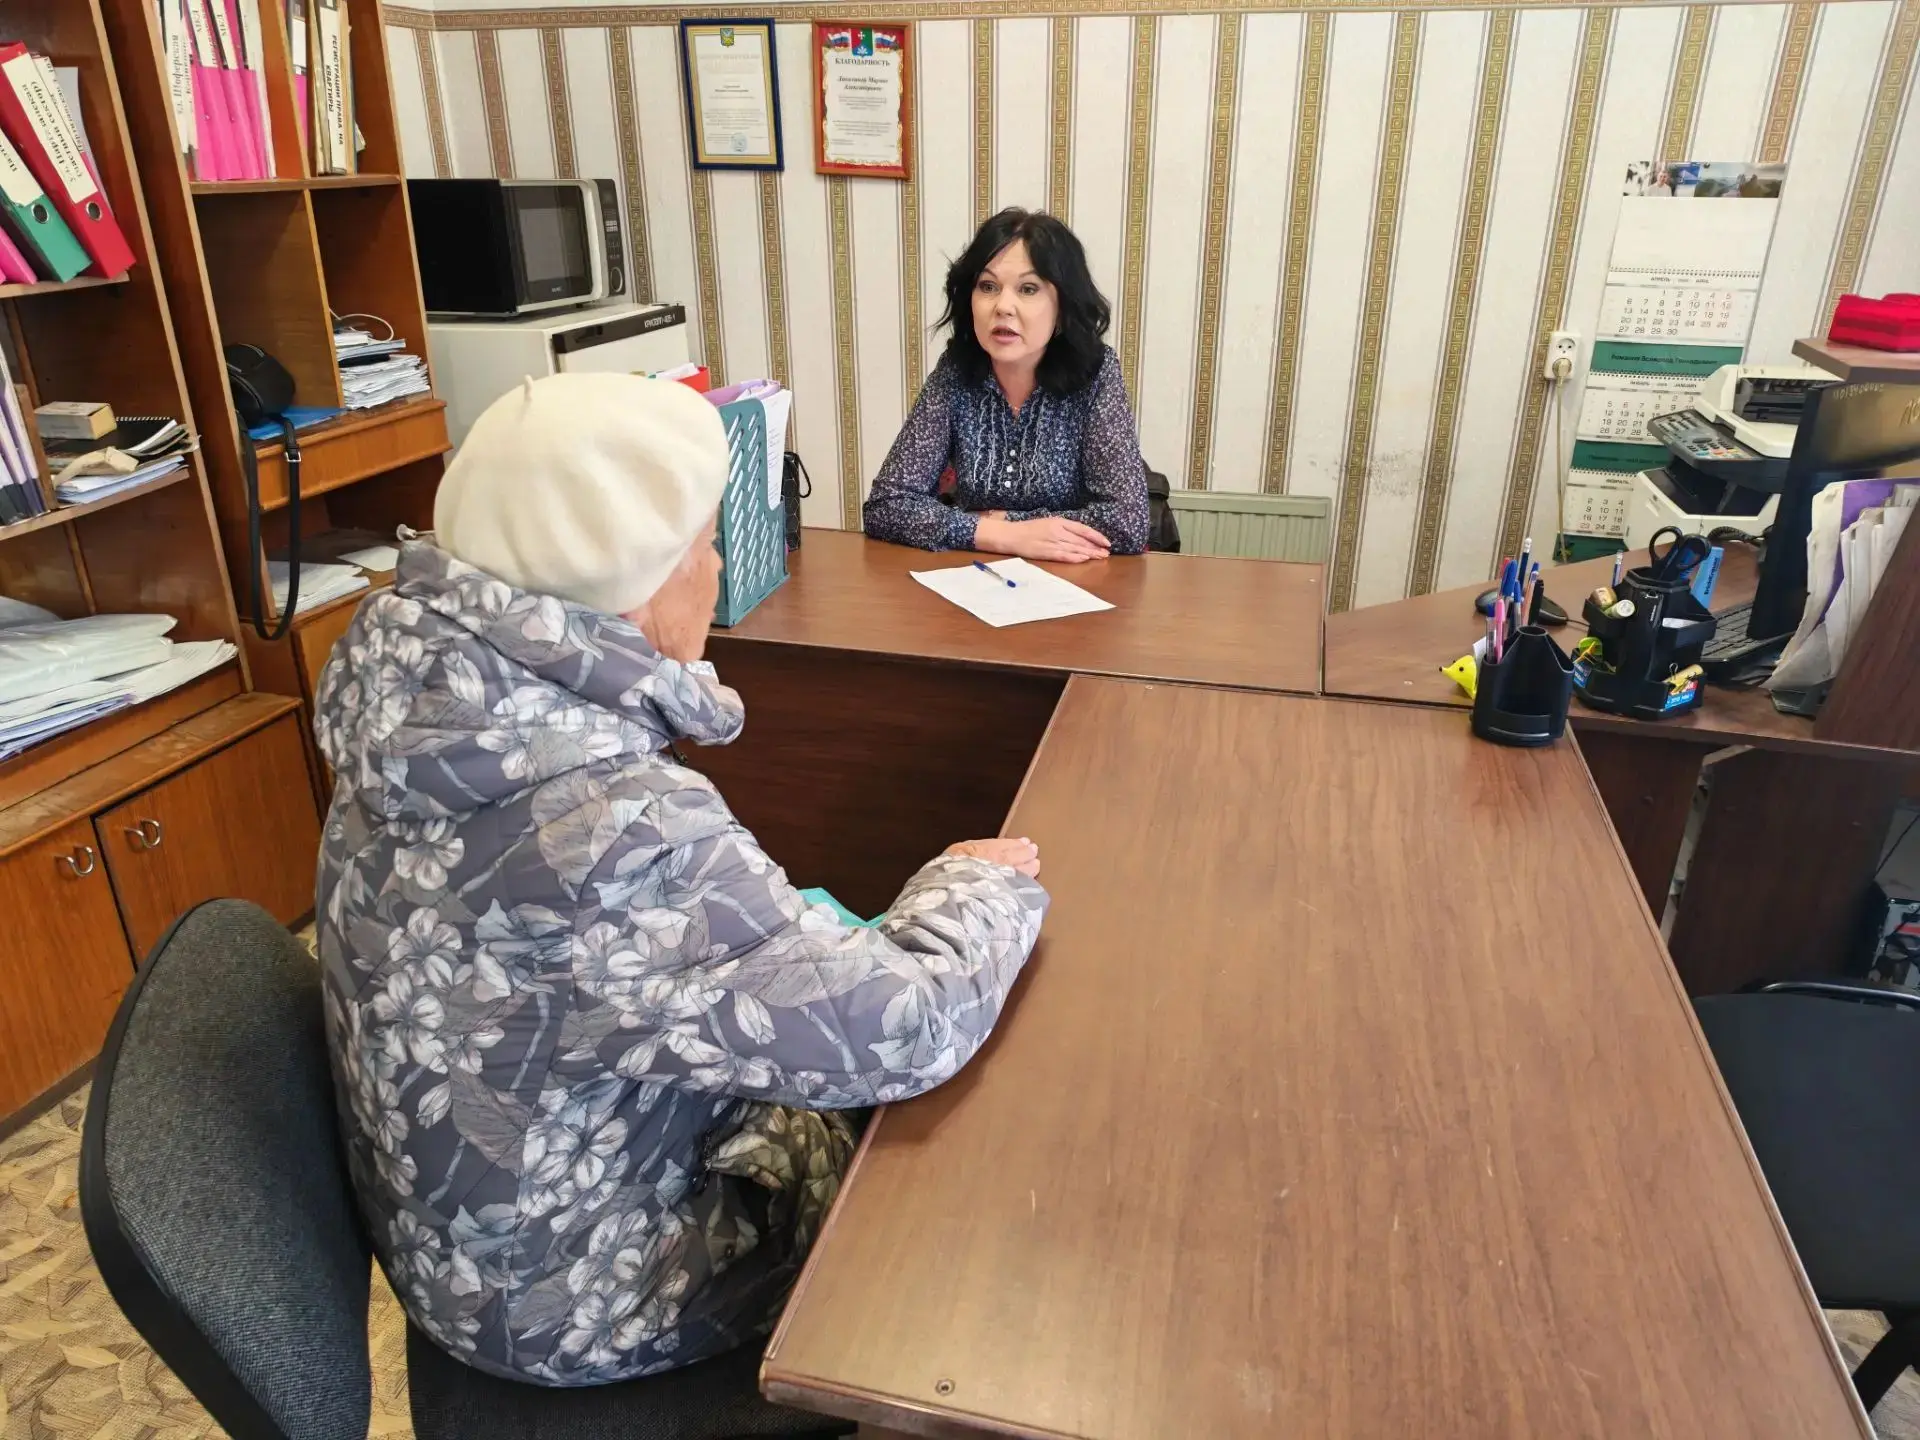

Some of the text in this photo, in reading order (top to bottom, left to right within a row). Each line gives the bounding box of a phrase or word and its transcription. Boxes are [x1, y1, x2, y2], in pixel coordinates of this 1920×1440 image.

[326, 64, 334, 113] КВАРТИРЫ
[332, 34, 342, 98] РЕГИСТРАЦИИ
[338, 132, 344, 145] НА
[1690, 301, 1700, 309] 10
[1634, 326, 1645, 334] 28
